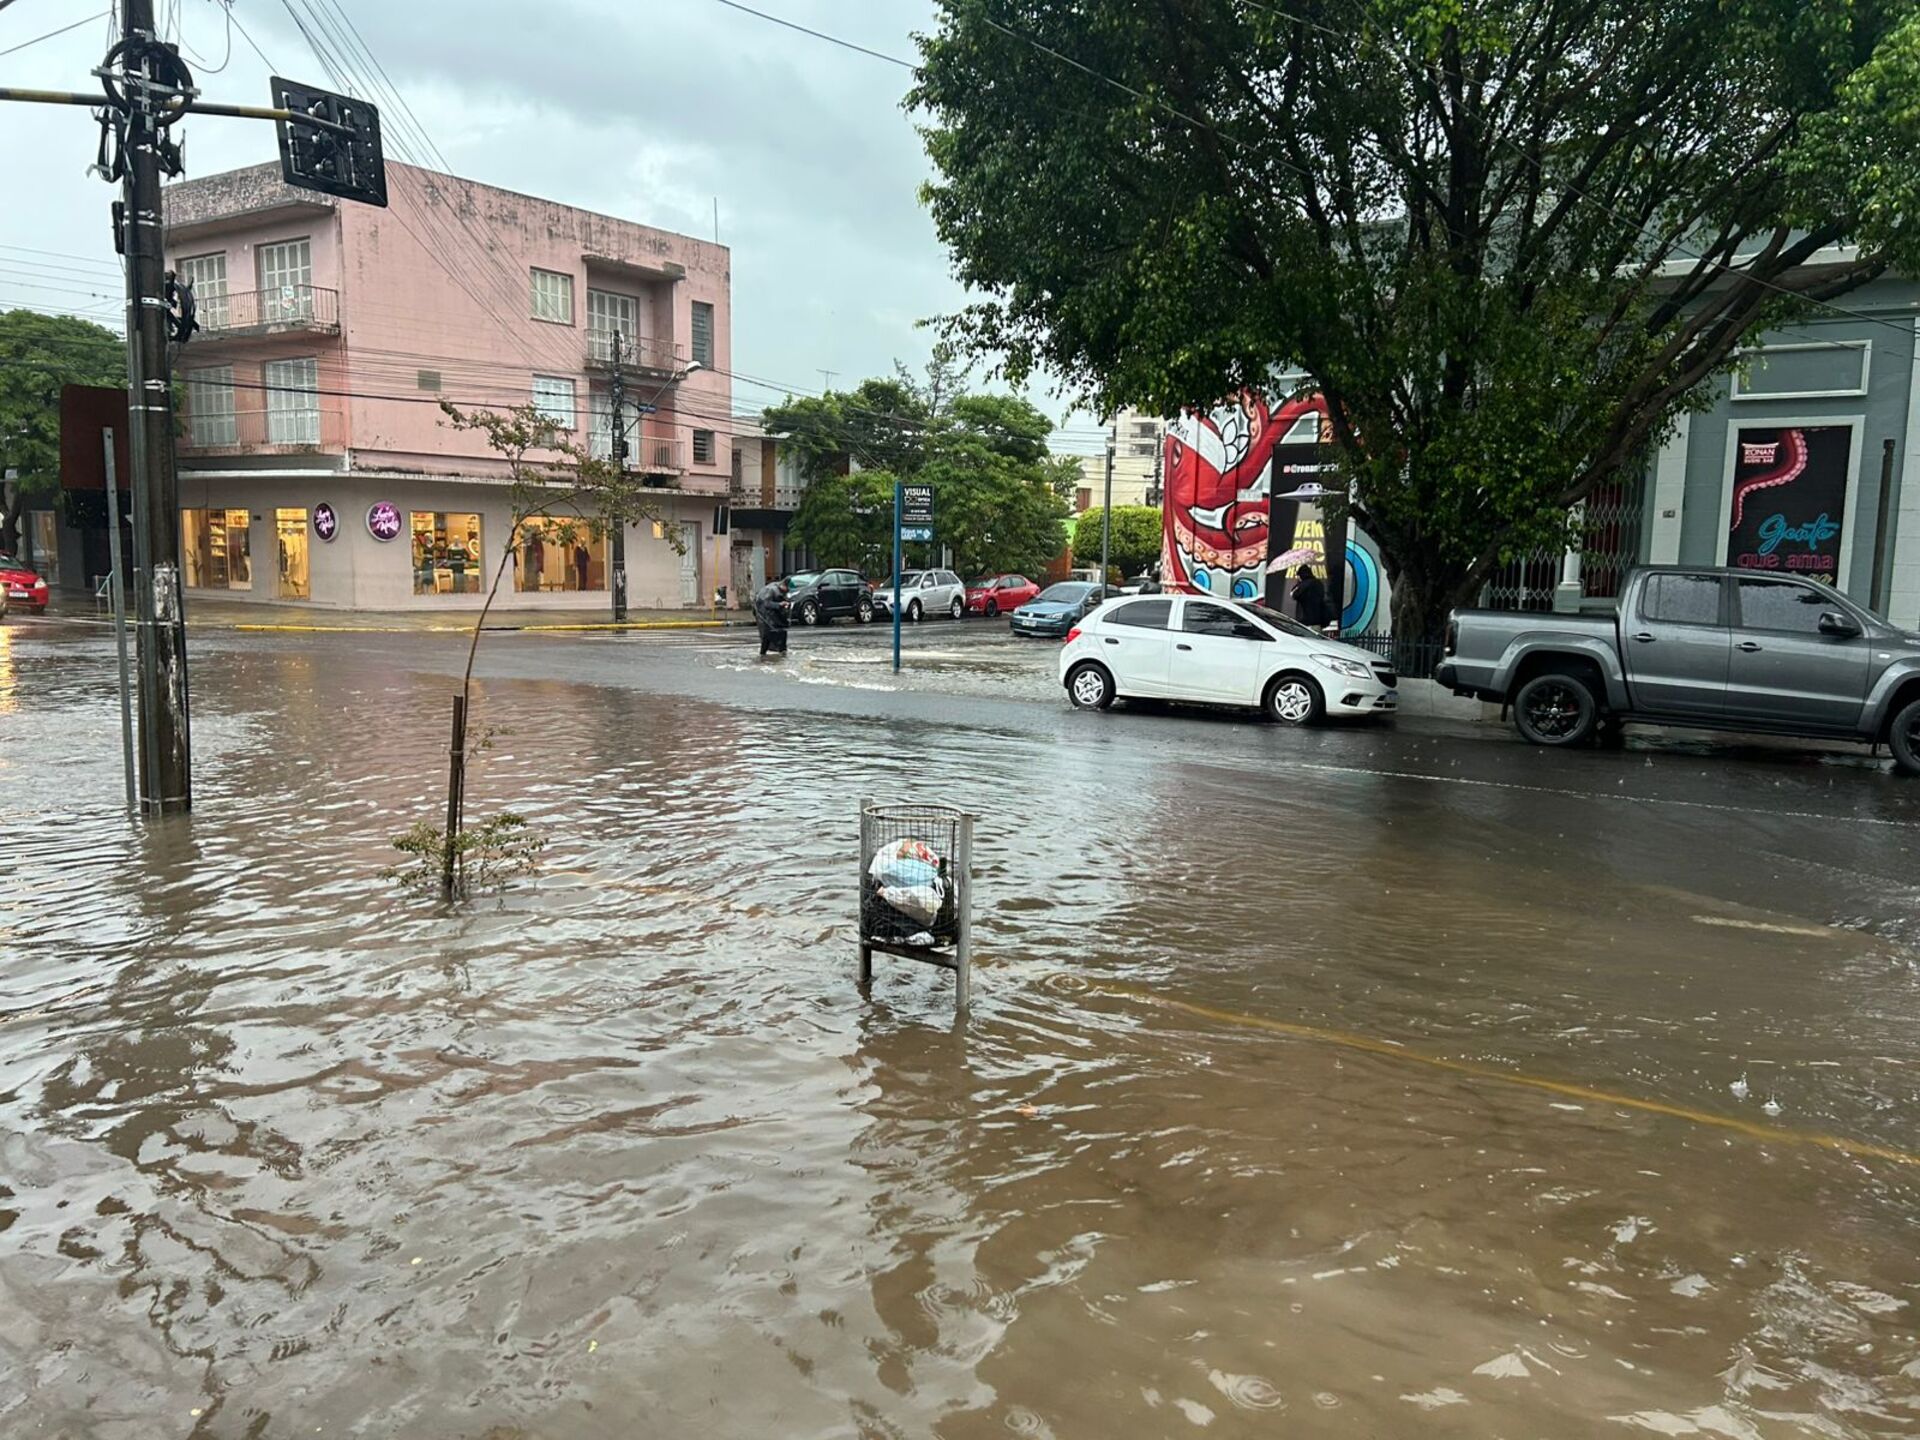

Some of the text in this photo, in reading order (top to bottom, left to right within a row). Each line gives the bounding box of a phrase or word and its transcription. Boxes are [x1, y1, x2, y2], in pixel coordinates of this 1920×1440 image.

[1745, 448, 1775, 456] RONAN
[904, 487, 930, 496] VISUAL
[1294, 520, 1325, 538] VEM
[1737, 553, 1833, 569] que ama
